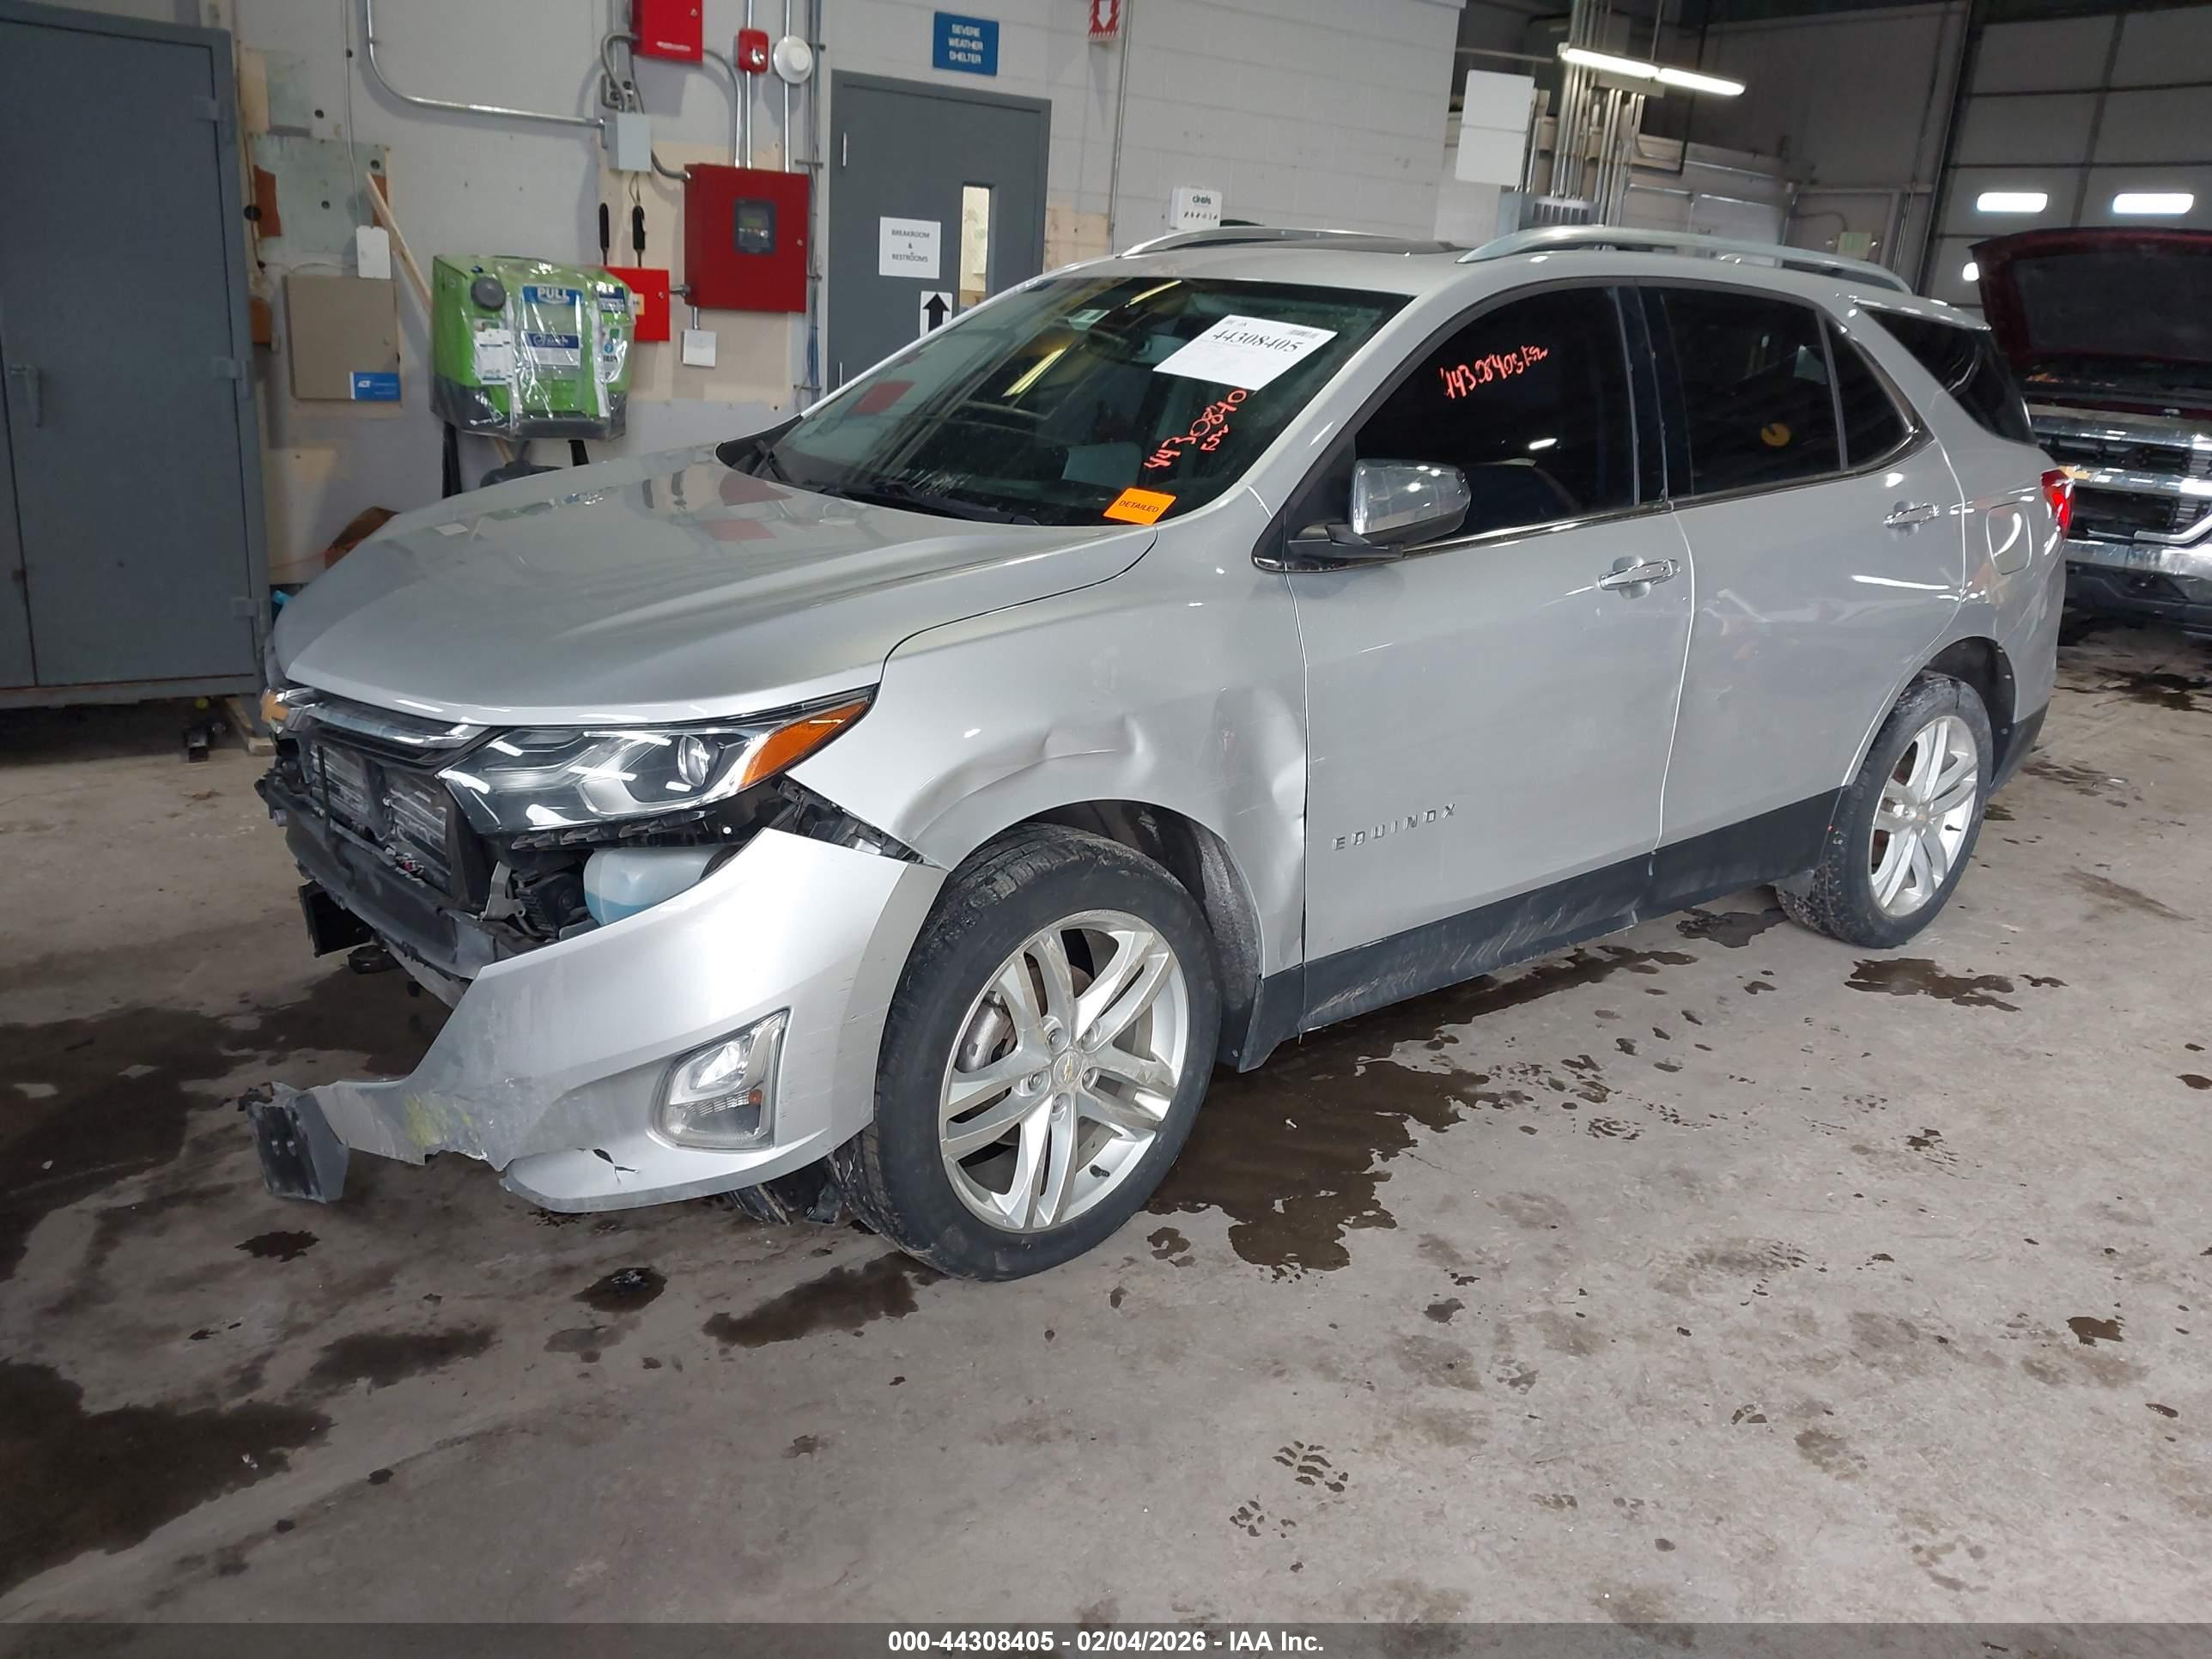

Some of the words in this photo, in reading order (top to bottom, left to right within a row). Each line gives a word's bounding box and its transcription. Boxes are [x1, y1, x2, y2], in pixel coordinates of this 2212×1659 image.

[951, 24, 981, 38] SEVERE
[948, 38, 983, 52] WEATHER
[949, 51, 981, 64] SHELTER
[891, 229, 930, 239] BREAKROOM
[891, 253, 928, 263] RESTROOMS
[537, 287, 570, 301] PULL
[1212, 330, 1304, 352] 44308405
[1119, 501, 1158, 513] DETAILED
[1332, 803, 1455, 851] EQUINOX
